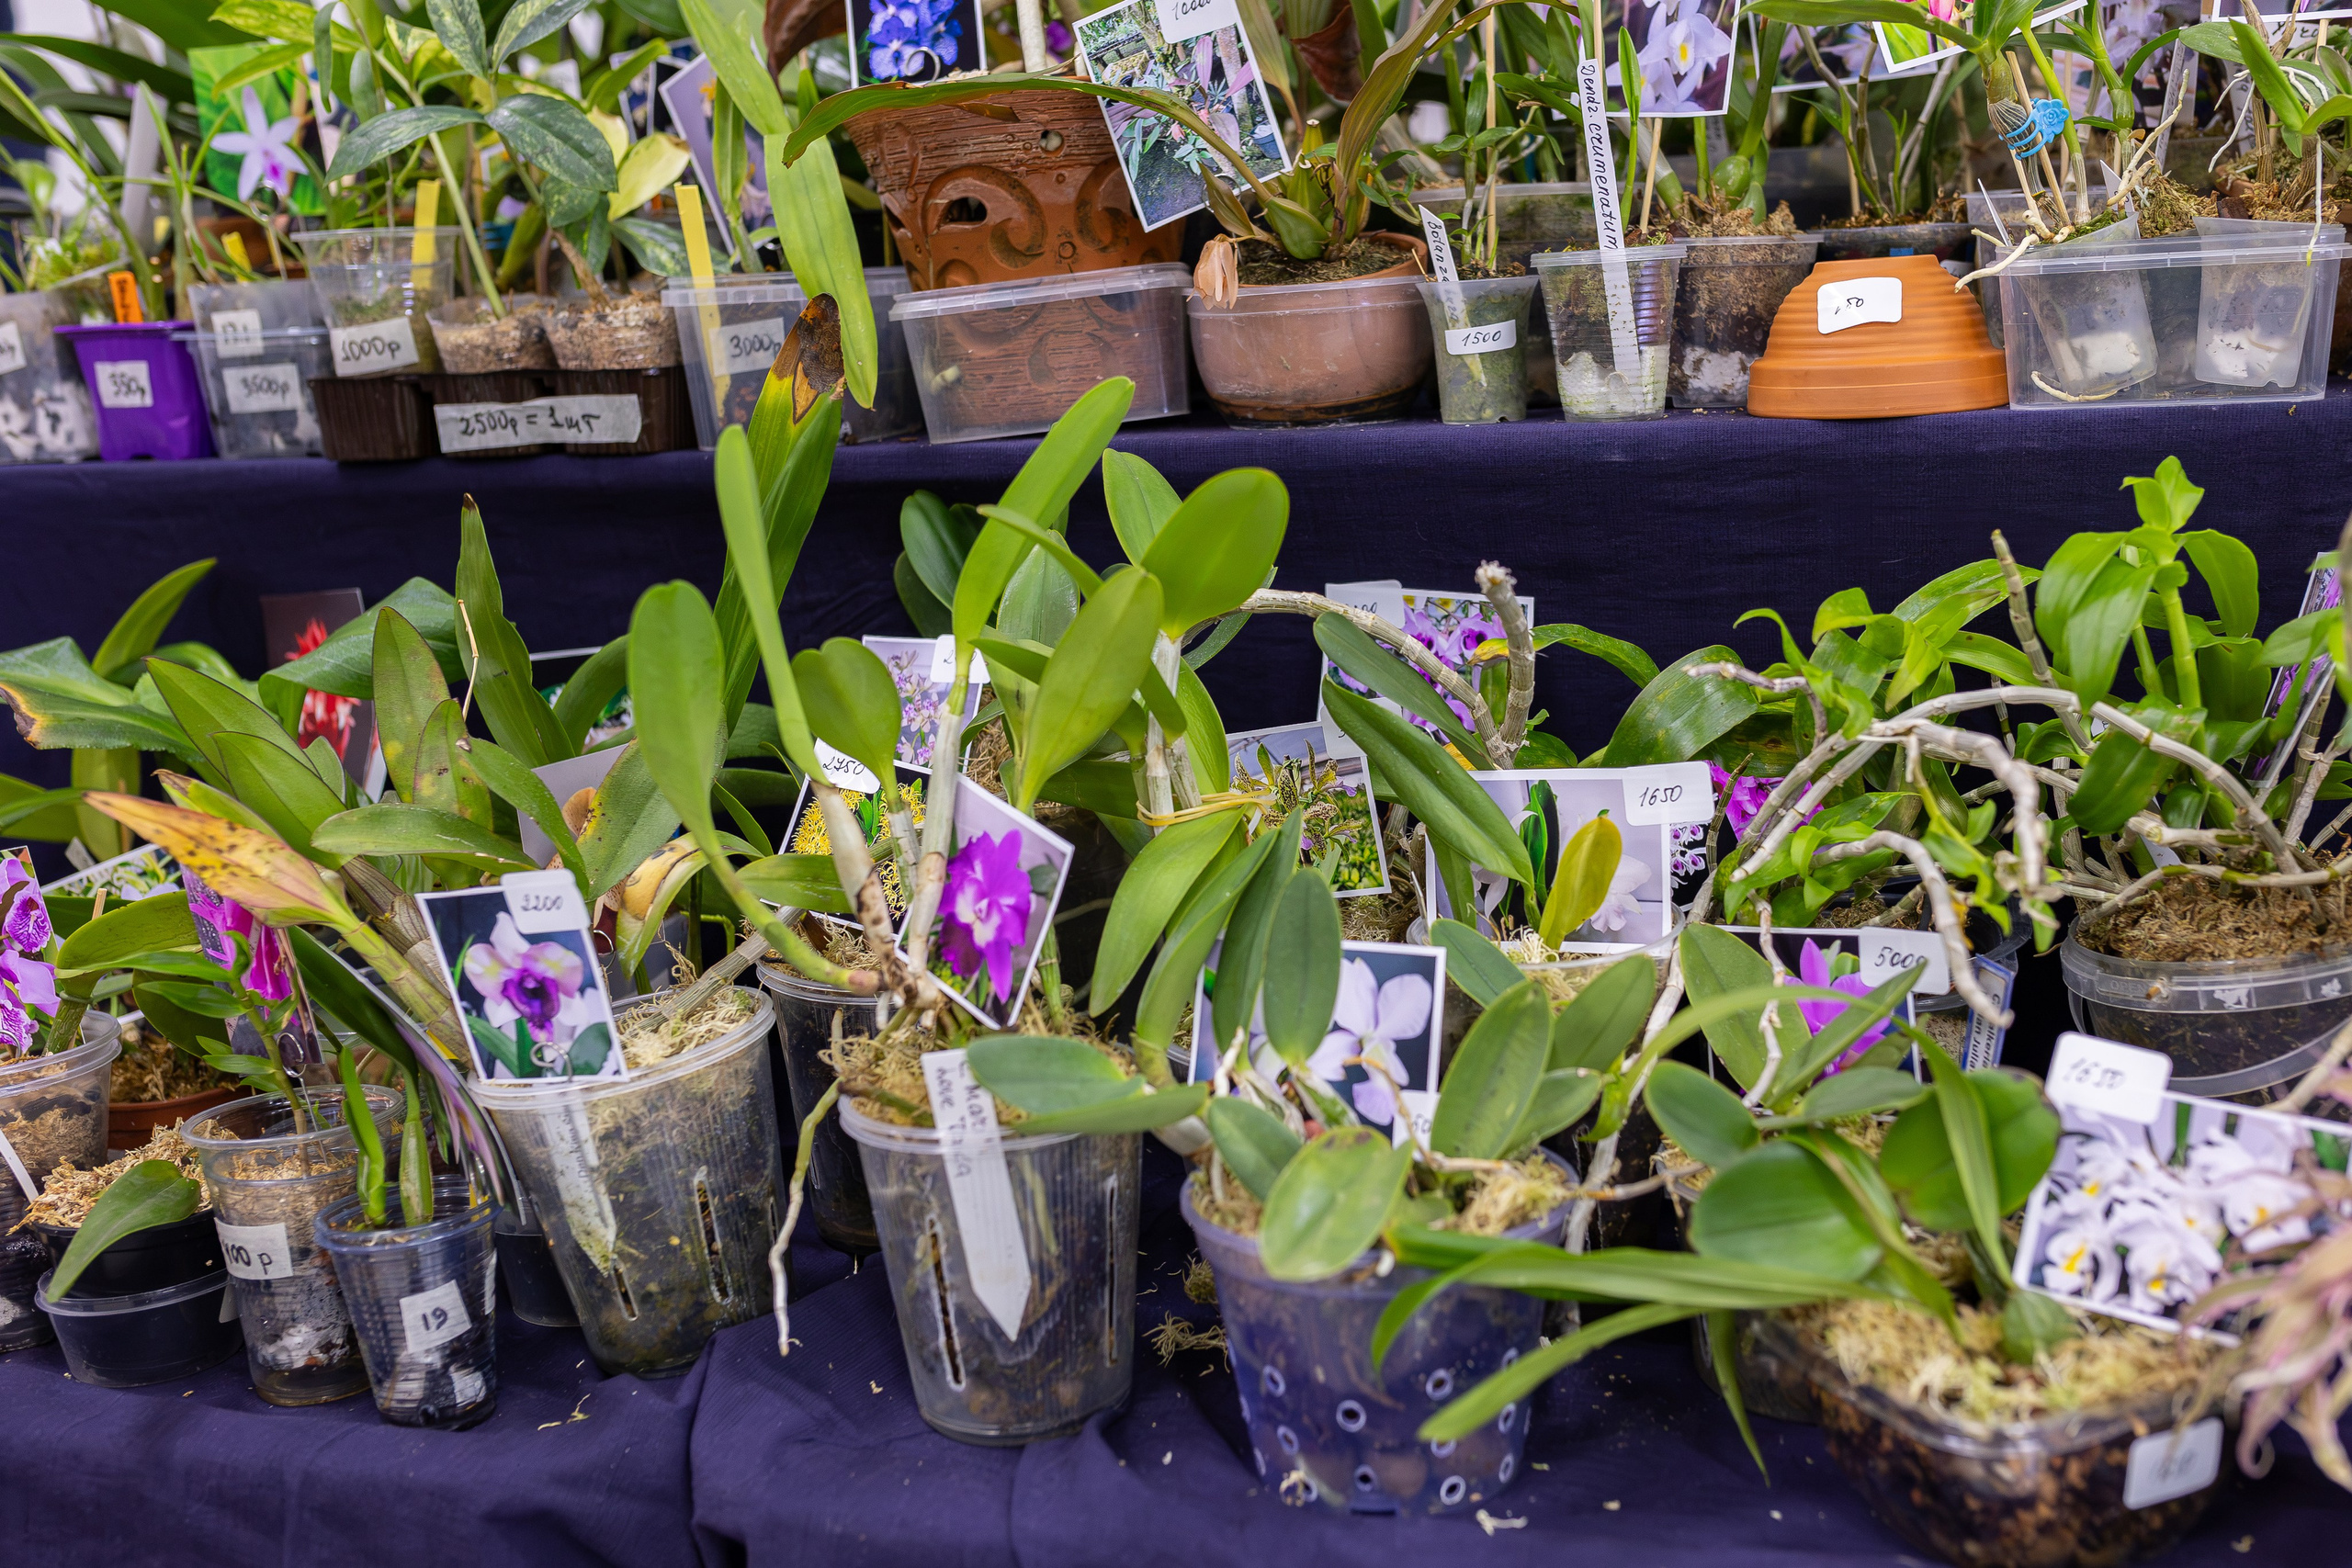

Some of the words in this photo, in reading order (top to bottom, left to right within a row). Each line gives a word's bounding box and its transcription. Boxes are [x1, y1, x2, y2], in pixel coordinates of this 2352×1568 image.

[1462, 330, 1502, 346] 1500
[1638, 784, 1683, 807] 1650
[422, 1306, 448, 1332] 19
